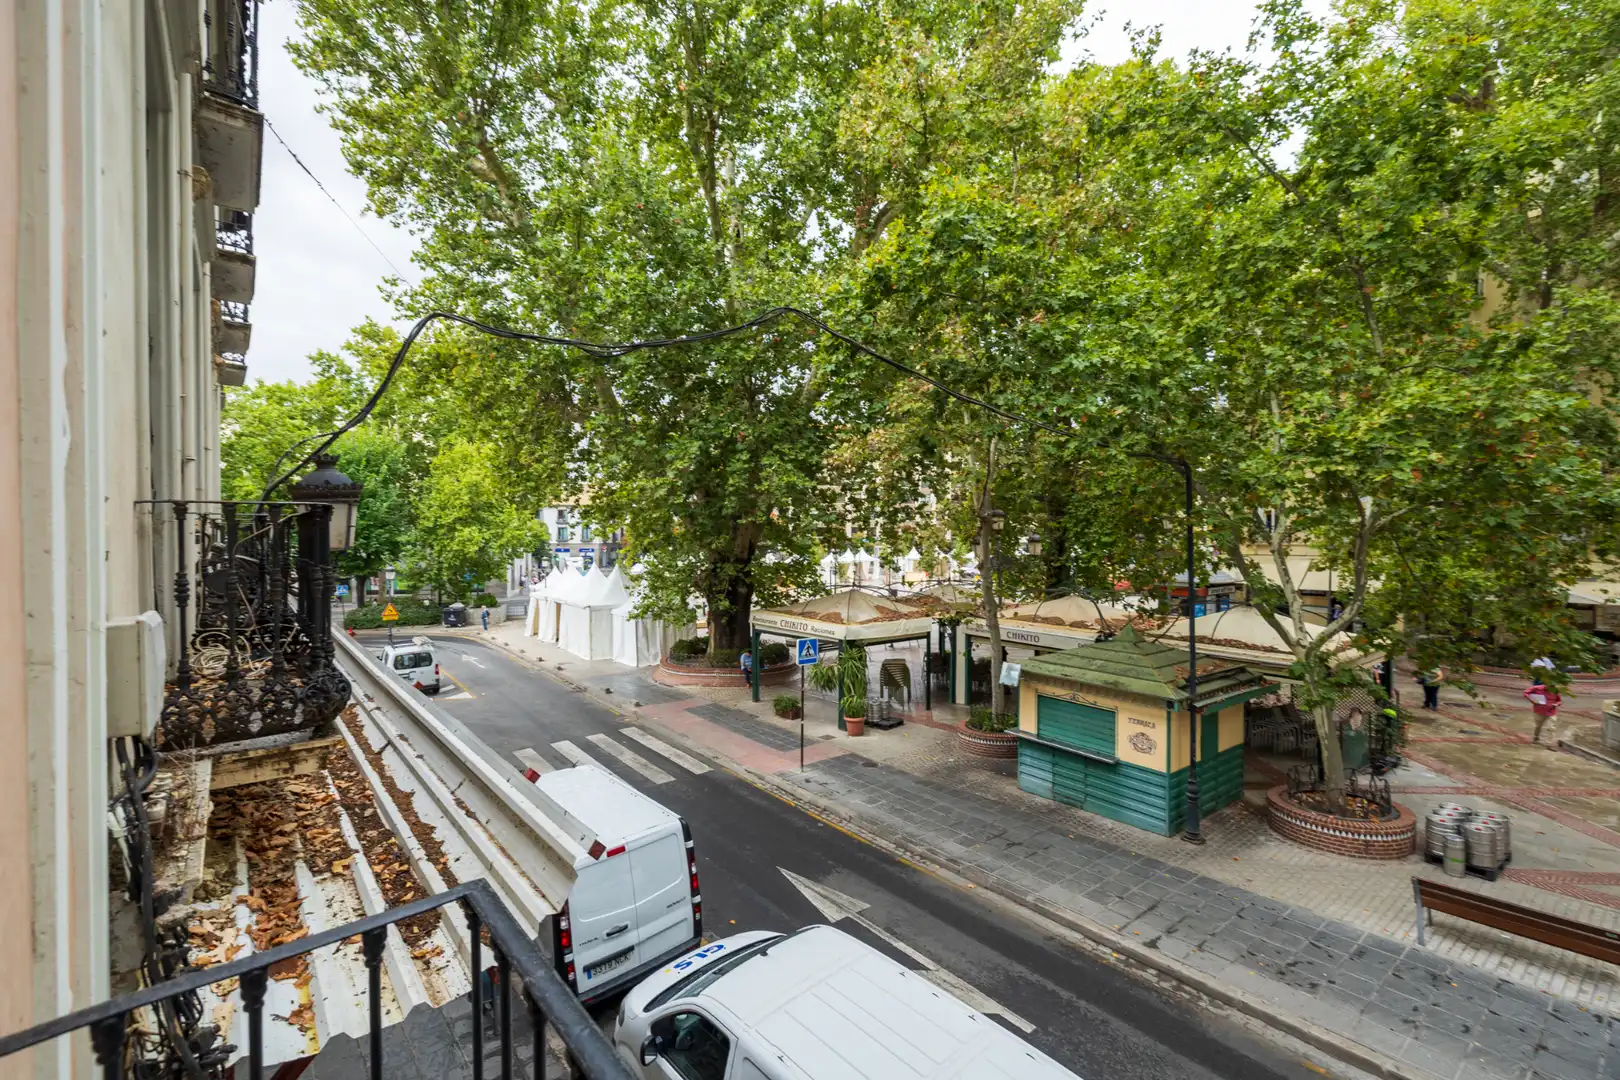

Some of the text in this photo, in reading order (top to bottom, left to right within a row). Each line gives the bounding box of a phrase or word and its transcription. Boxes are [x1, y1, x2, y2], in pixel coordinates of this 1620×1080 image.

[780, 620, 808, 631] CHIKITO
[811, 626, 835, 636] Raciones
[1006, 631, 1040, 643] CHIKITO
[673, 944, 725, 970] GLS
